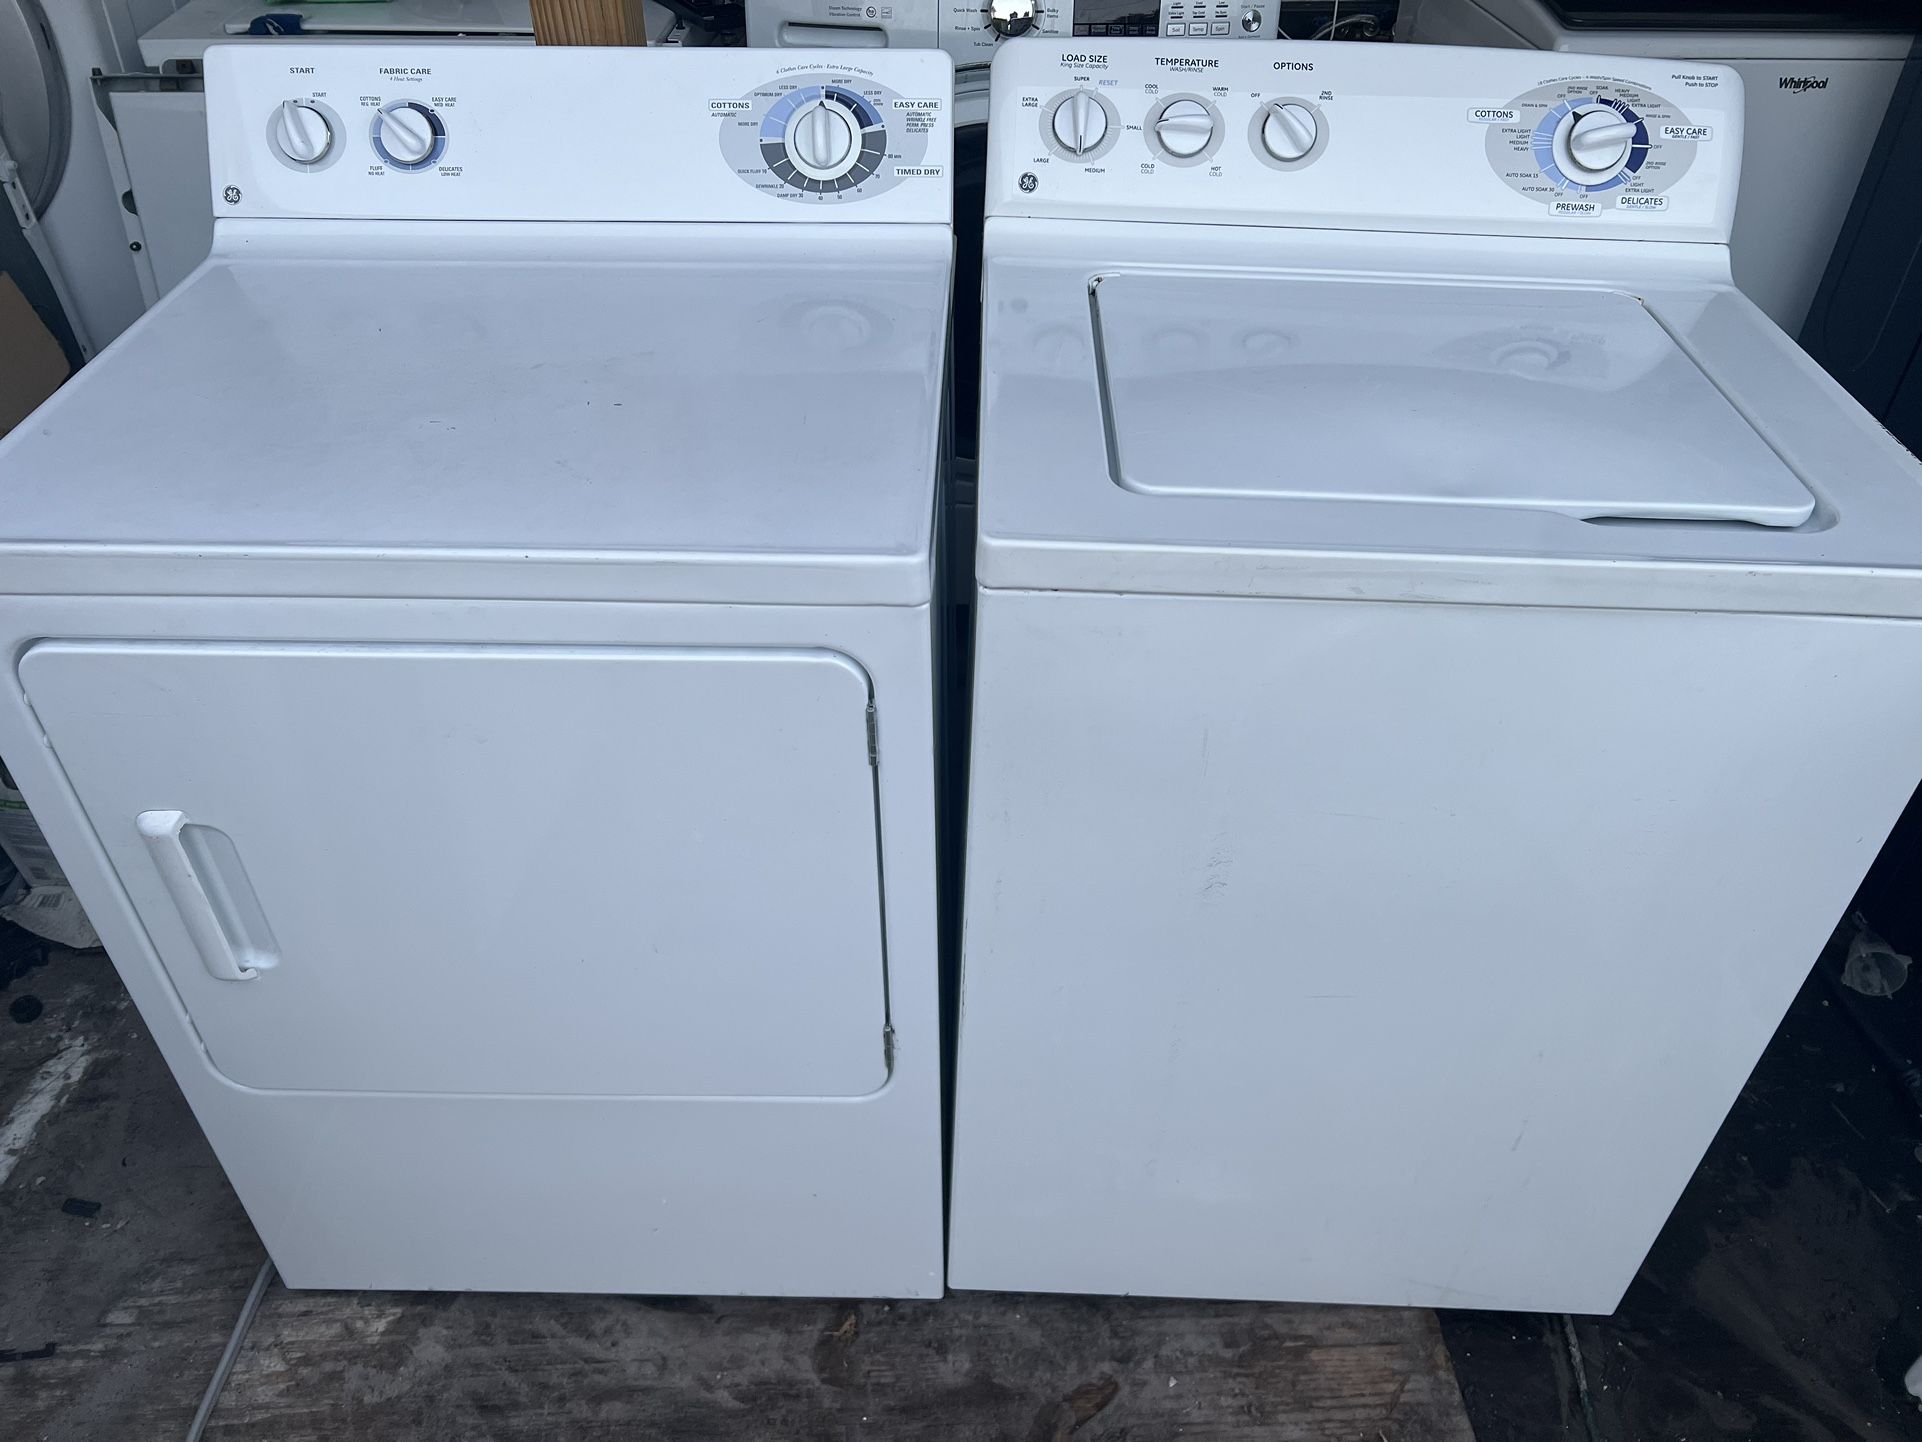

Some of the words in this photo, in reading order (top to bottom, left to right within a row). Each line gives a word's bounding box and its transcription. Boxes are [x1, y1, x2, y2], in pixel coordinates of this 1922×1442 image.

[1062, 54, 1086, 62] LOAD
[1089, 55, 1108, 64] SIZE
[1154, 57, 1219, 68] TEMPERATURE
[1273, 61, 1314, 71] OPTIONS
[854, 67, 874, 76] Capacity
[1779, 76, 1829, 94] Whirlpool
[1475, 110, 1514, 119] COTTONS
[1664, 127, 1685, 135] EASY
[1686, 128, 1707, 136] CARE
[1620, 196, 1663, 205] DELICATES
[1556, 203, 1595, 212] PREWASH
